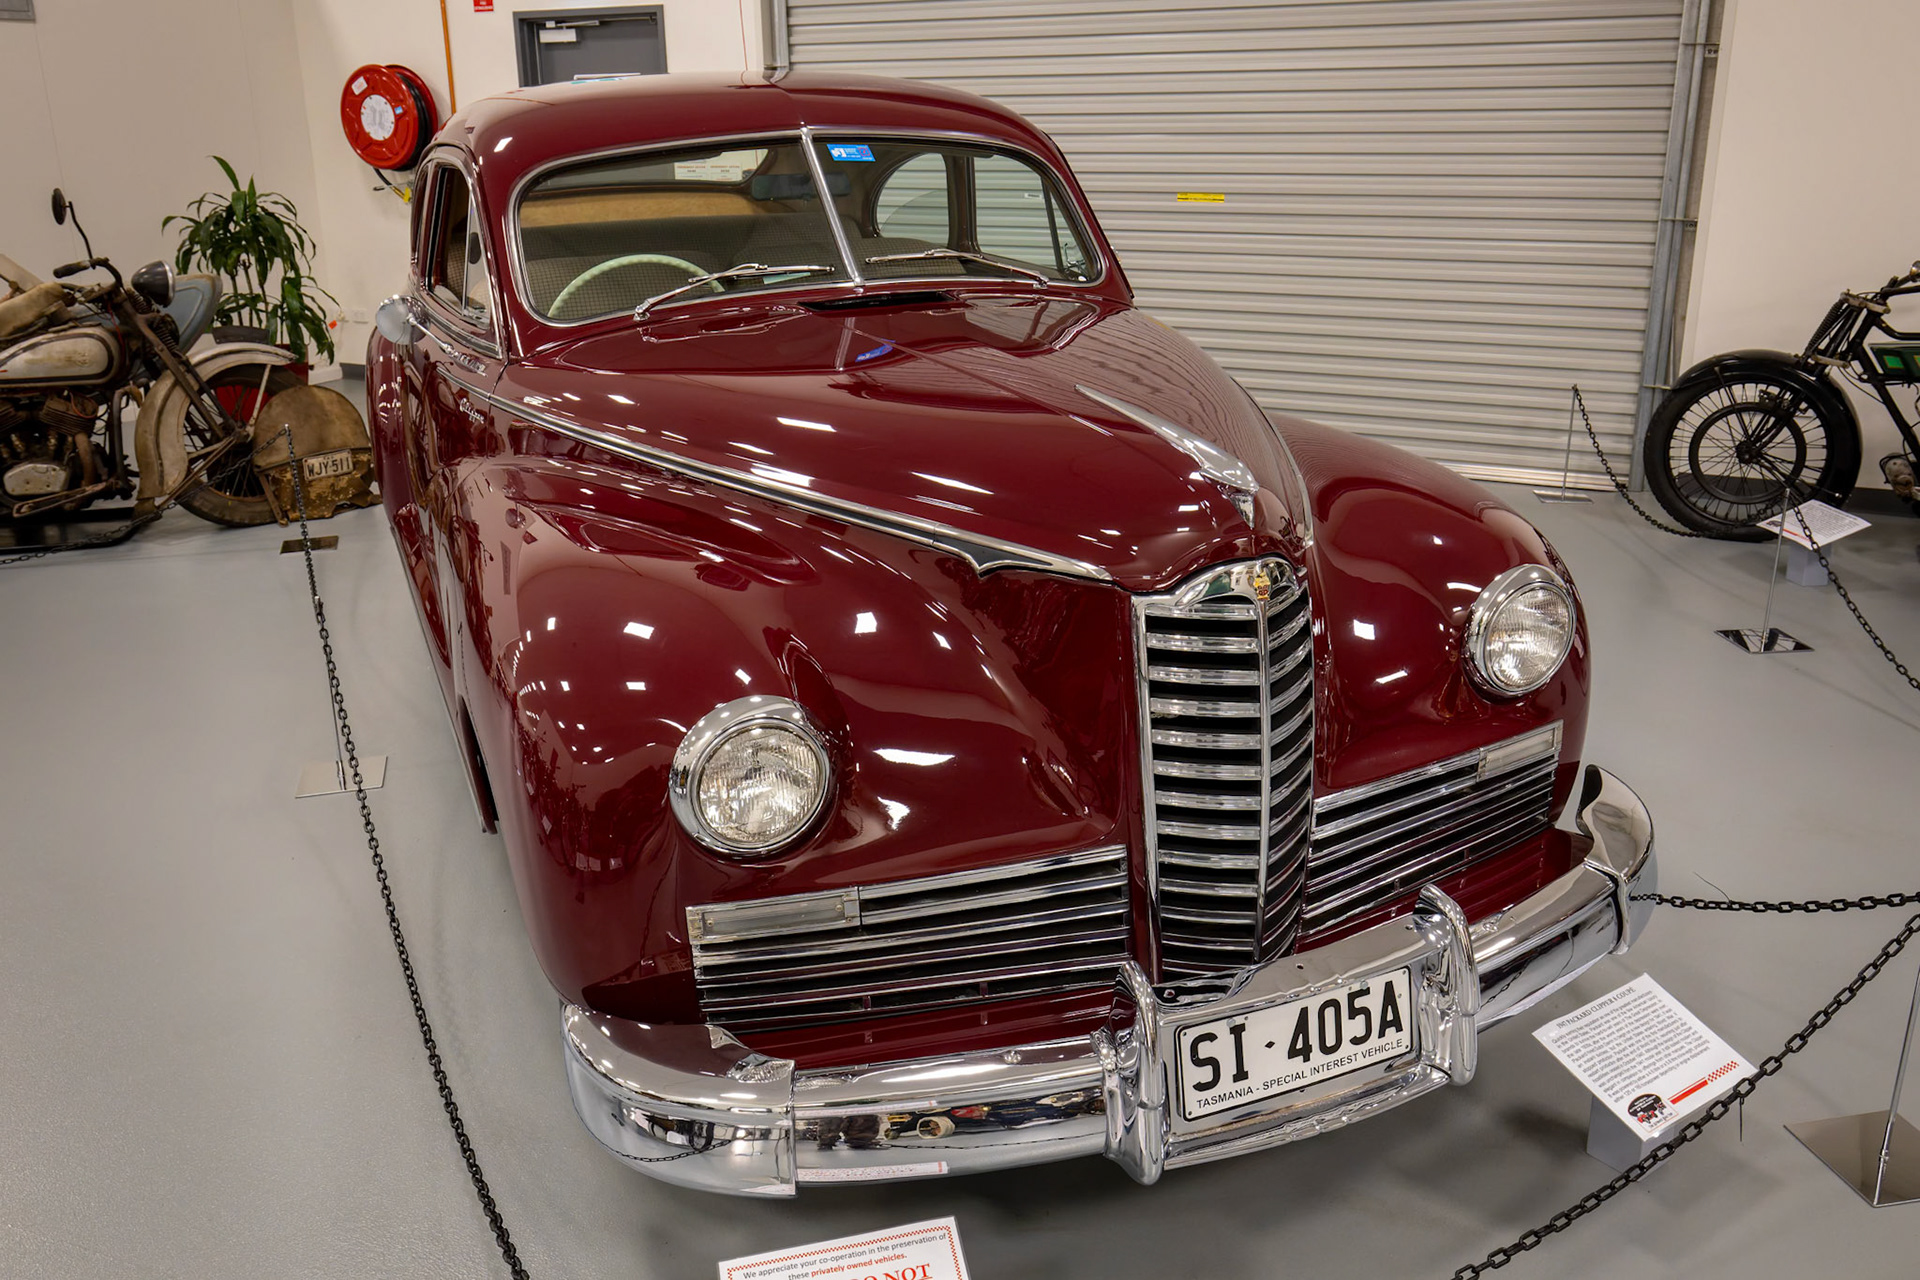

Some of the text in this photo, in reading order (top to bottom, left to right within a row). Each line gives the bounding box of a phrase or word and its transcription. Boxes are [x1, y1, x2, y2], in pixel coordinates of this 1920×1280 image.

[1288, 980, 1404, 1063] 405A
[1567, 1010, 1593, 1025] PACKARD
[1591, 999, 1614, 1013] CLIPPER
[1196, 1086, 1254, 1110] TASMANIA
[1262, 1070, 1308, 1092] SPECIAL
[1310, 1053, 1358, 1080] INTEREST
[1360, 1038, 1403, 1060] VEHICLE
[758, 1263, 798, 1276] appreciate
[800, 1260, 817, 1268] your
[819, 1249, 867, 1265] co-operation
[877, 1244, 890, 1253] the
[891, 1235, 937, 1250] preservation
[788, 1253, 907, 1280] these privately owned vehicles.
